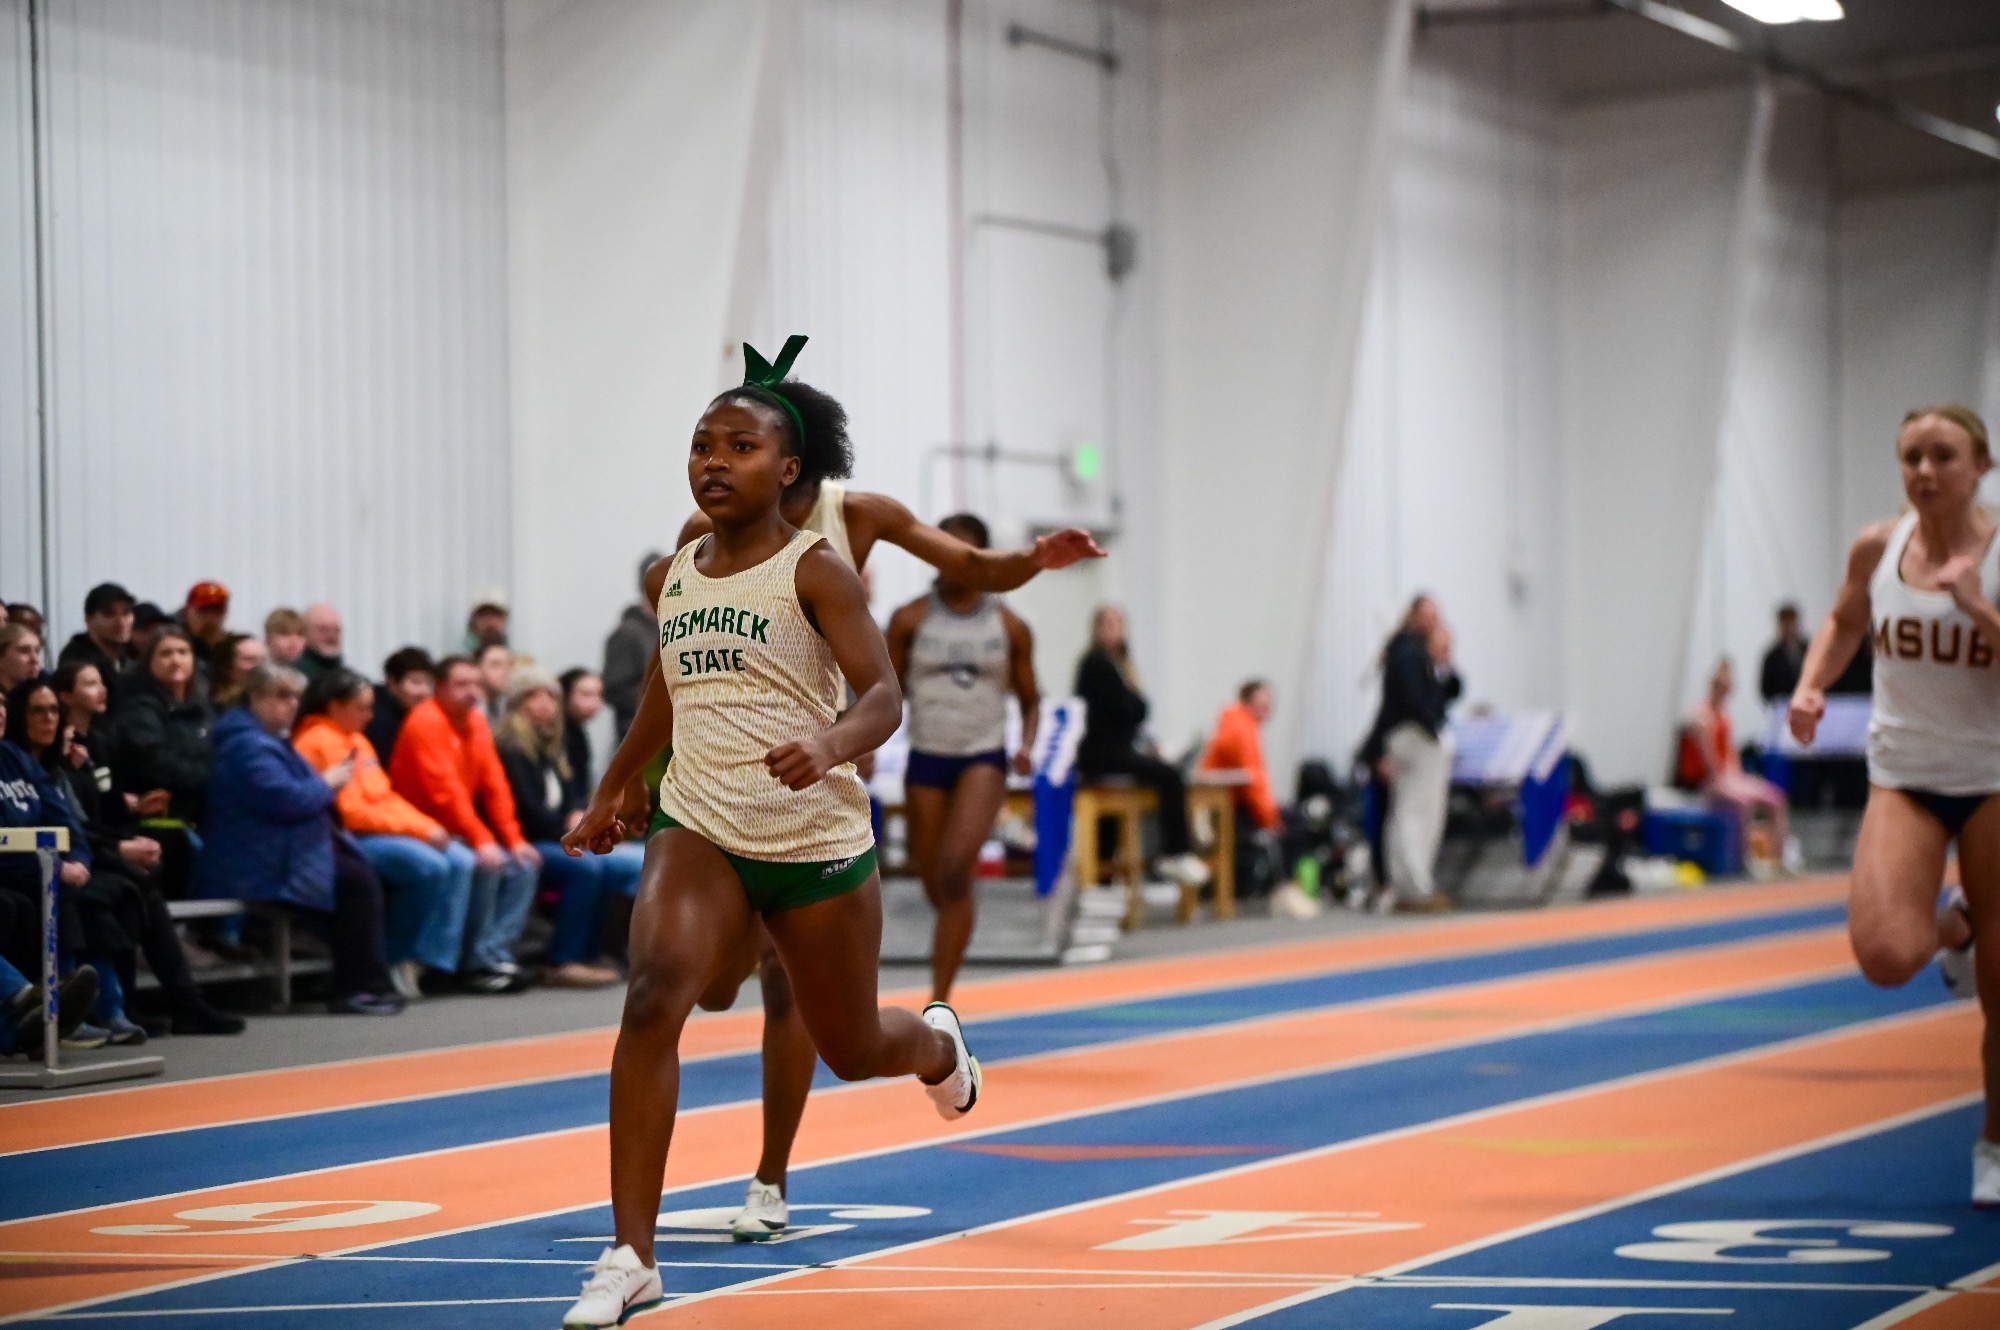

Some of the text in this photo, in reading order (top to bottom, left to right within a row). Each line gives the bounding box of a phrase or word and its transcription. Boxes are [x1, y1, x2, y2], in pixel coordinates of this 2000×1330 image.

[661, 606, 770, 650] BISMARCK
[679, 648, 746, 676] STATE
[1088, 1209, 1426, 1251] 4
[1613, 1218, 1956, 1264] 3
